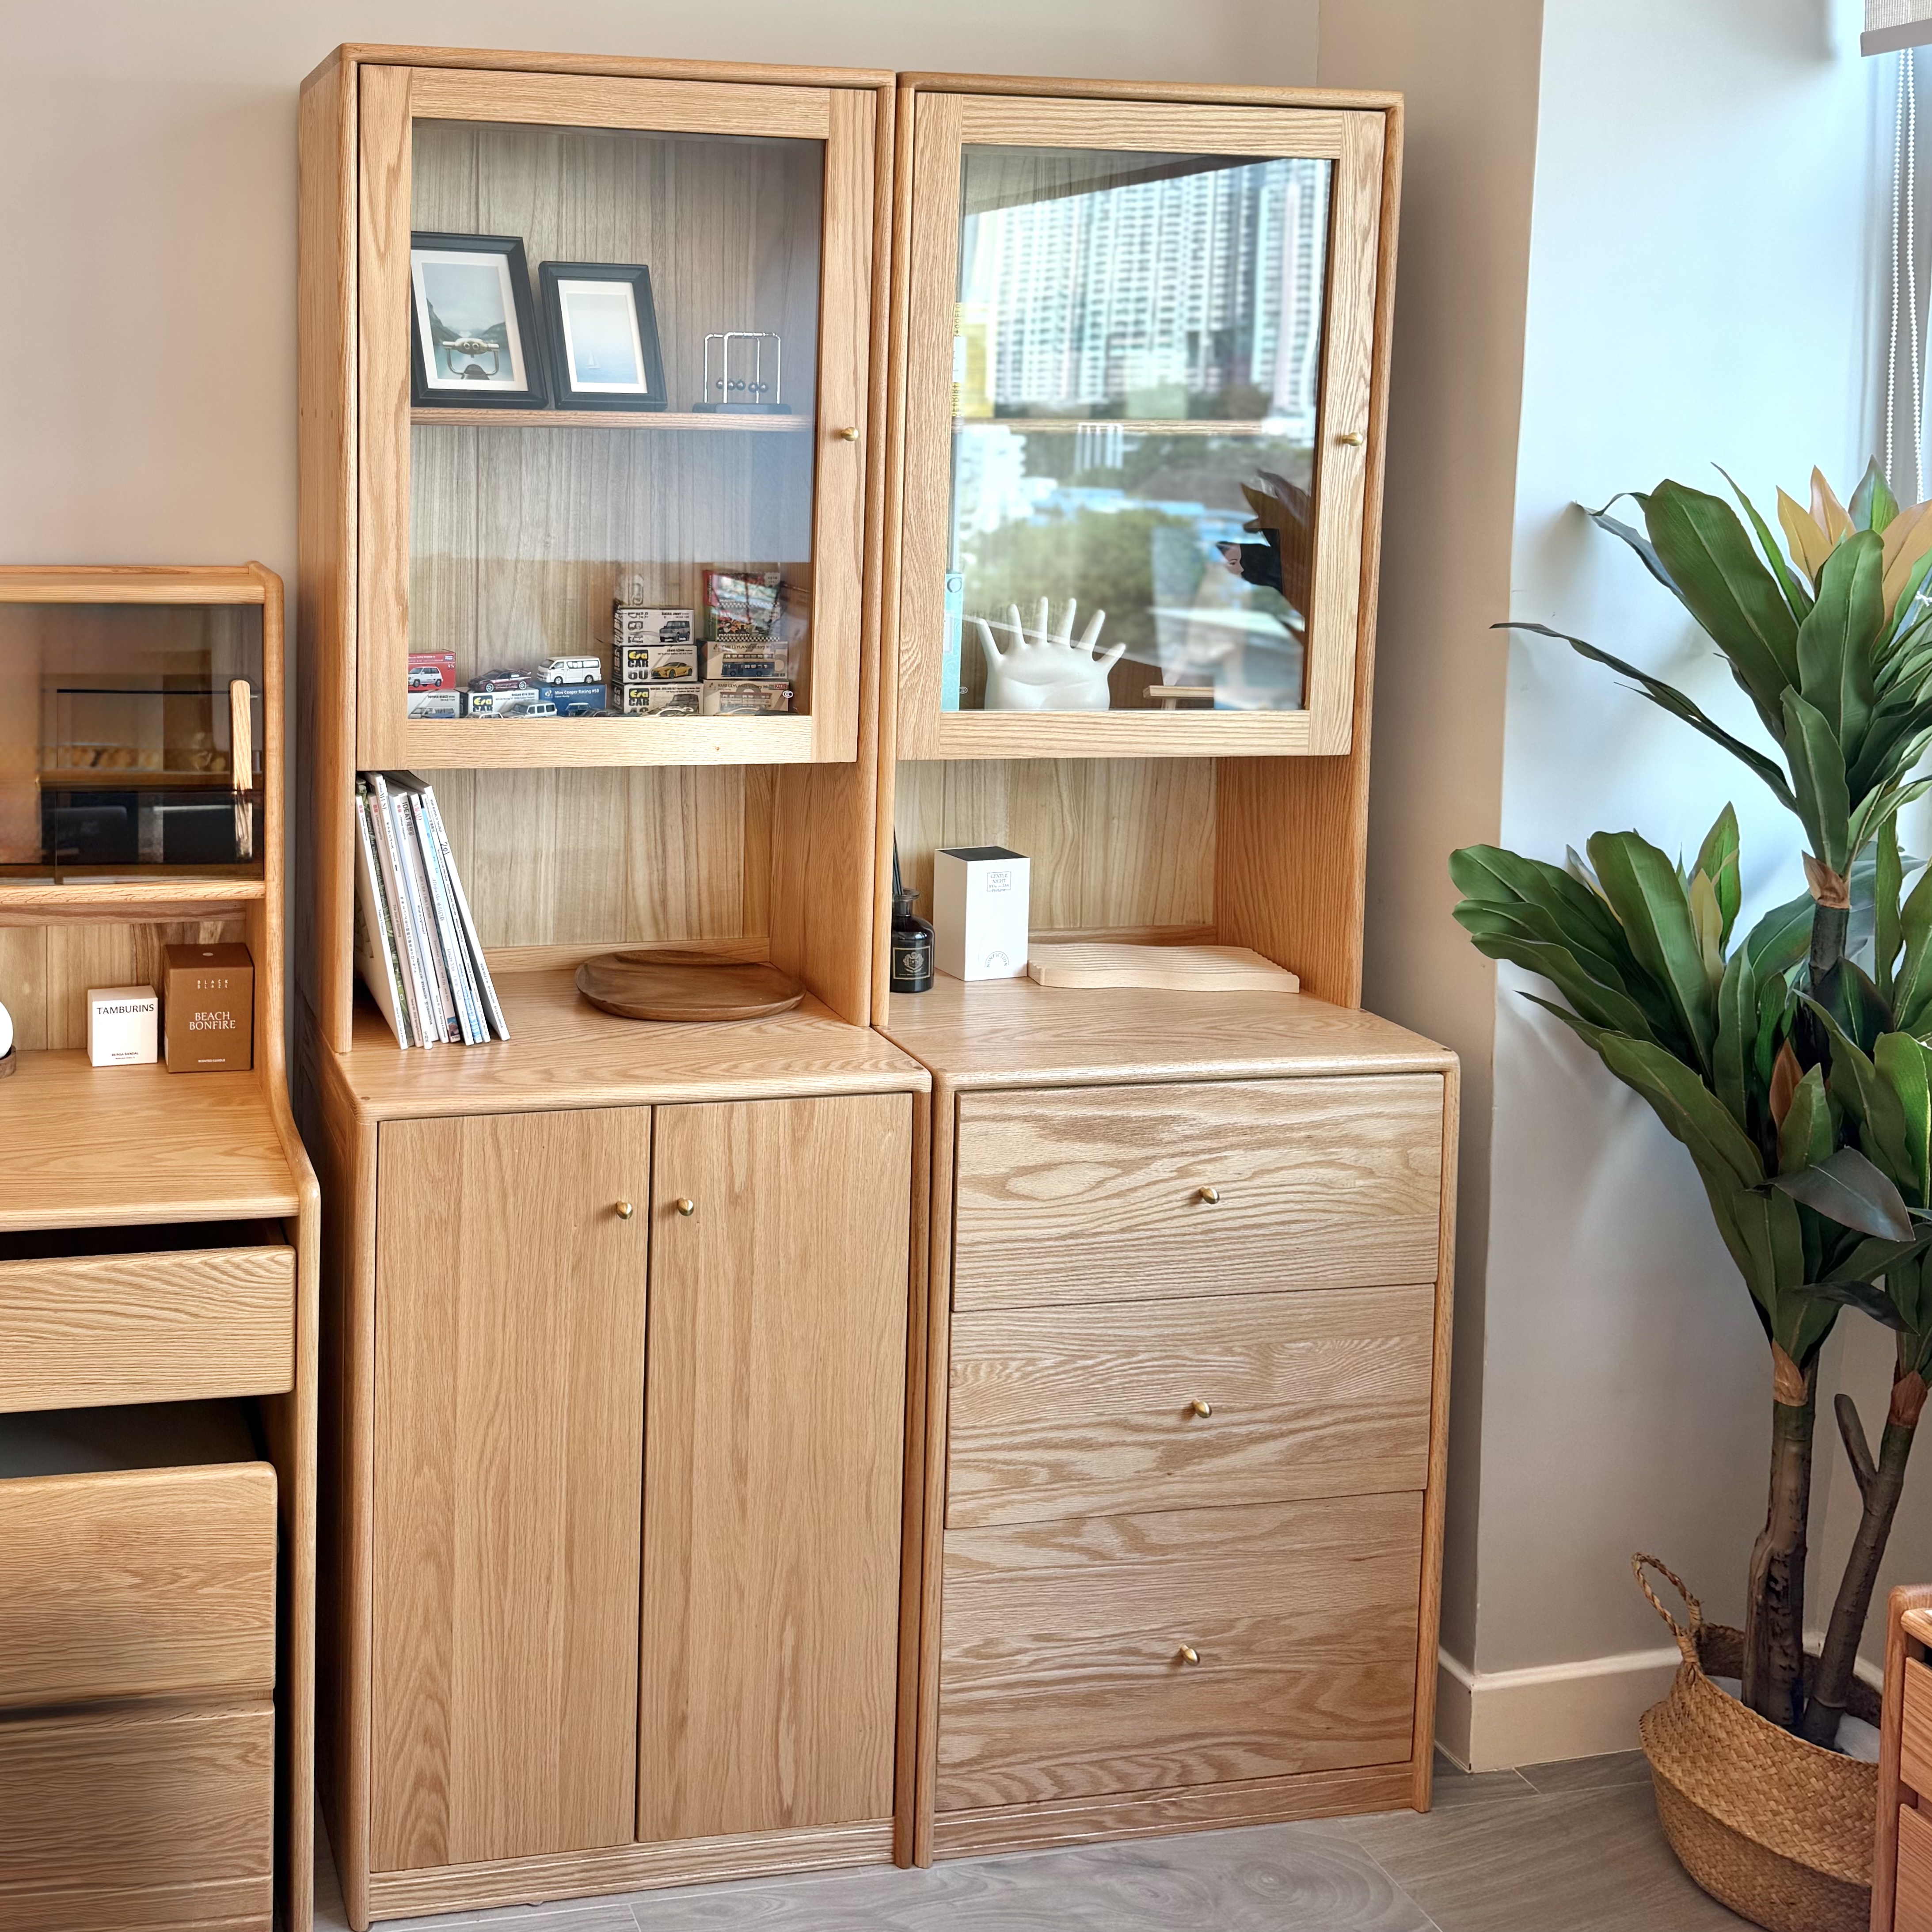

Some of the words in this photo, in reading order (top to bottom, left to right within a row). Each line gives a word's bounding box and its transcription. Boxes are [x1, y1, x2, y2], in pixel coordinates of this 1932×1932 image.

[628, 651, 648, 659] Era
[474, 697, 492, 705] Era
[402, 802, 411, 820] IDEAT
[986, 952, 1008, 968] NONFICTION
[96, 1004, 154, 1015] TAMBURINS
[195, 1011, 230, 1021] BEACH
[189, 1020, 236, 1031] BONFIRE
